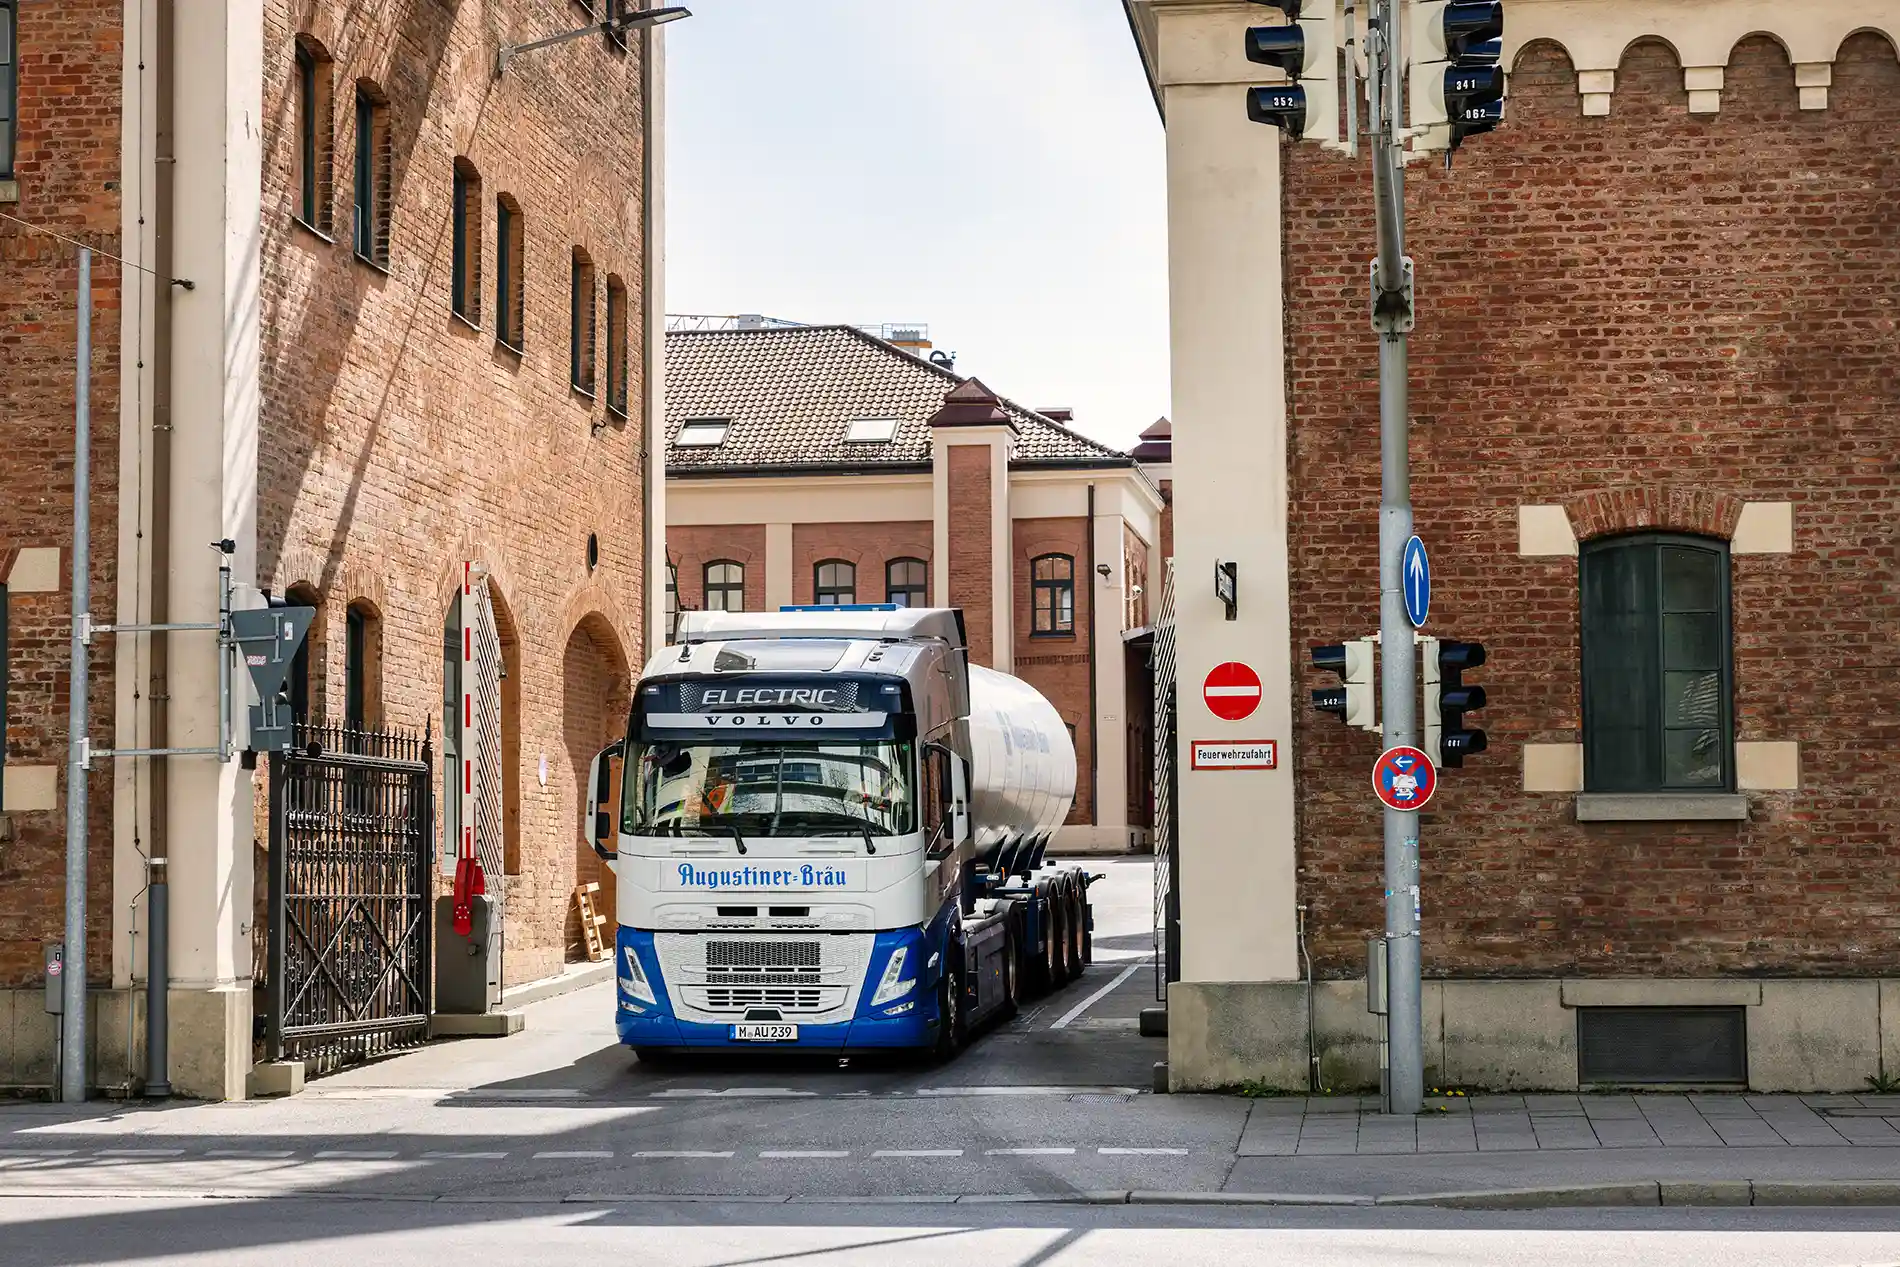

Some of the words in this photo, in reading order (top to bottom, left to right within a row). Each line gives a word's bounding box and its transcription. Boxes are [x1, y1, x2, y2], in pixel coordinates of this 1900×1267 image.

[1456, 78, 1476, 91] 341
[1273, 96, 1294, 107] 352
[1465, 108, 1486, 120] 062
[701, 688, 838, 705] ELECTRIC
[1323, 698, 1339, 706] 542
[704, 715, 824, 726] VOLVO
[1198, 748, 1272, 760] Feuerwehrzufahrt
[738, 1026, 747, 1038] M
[754, 1026, 769, 1038] AU
[770, 1026, 792, 1038] 239
